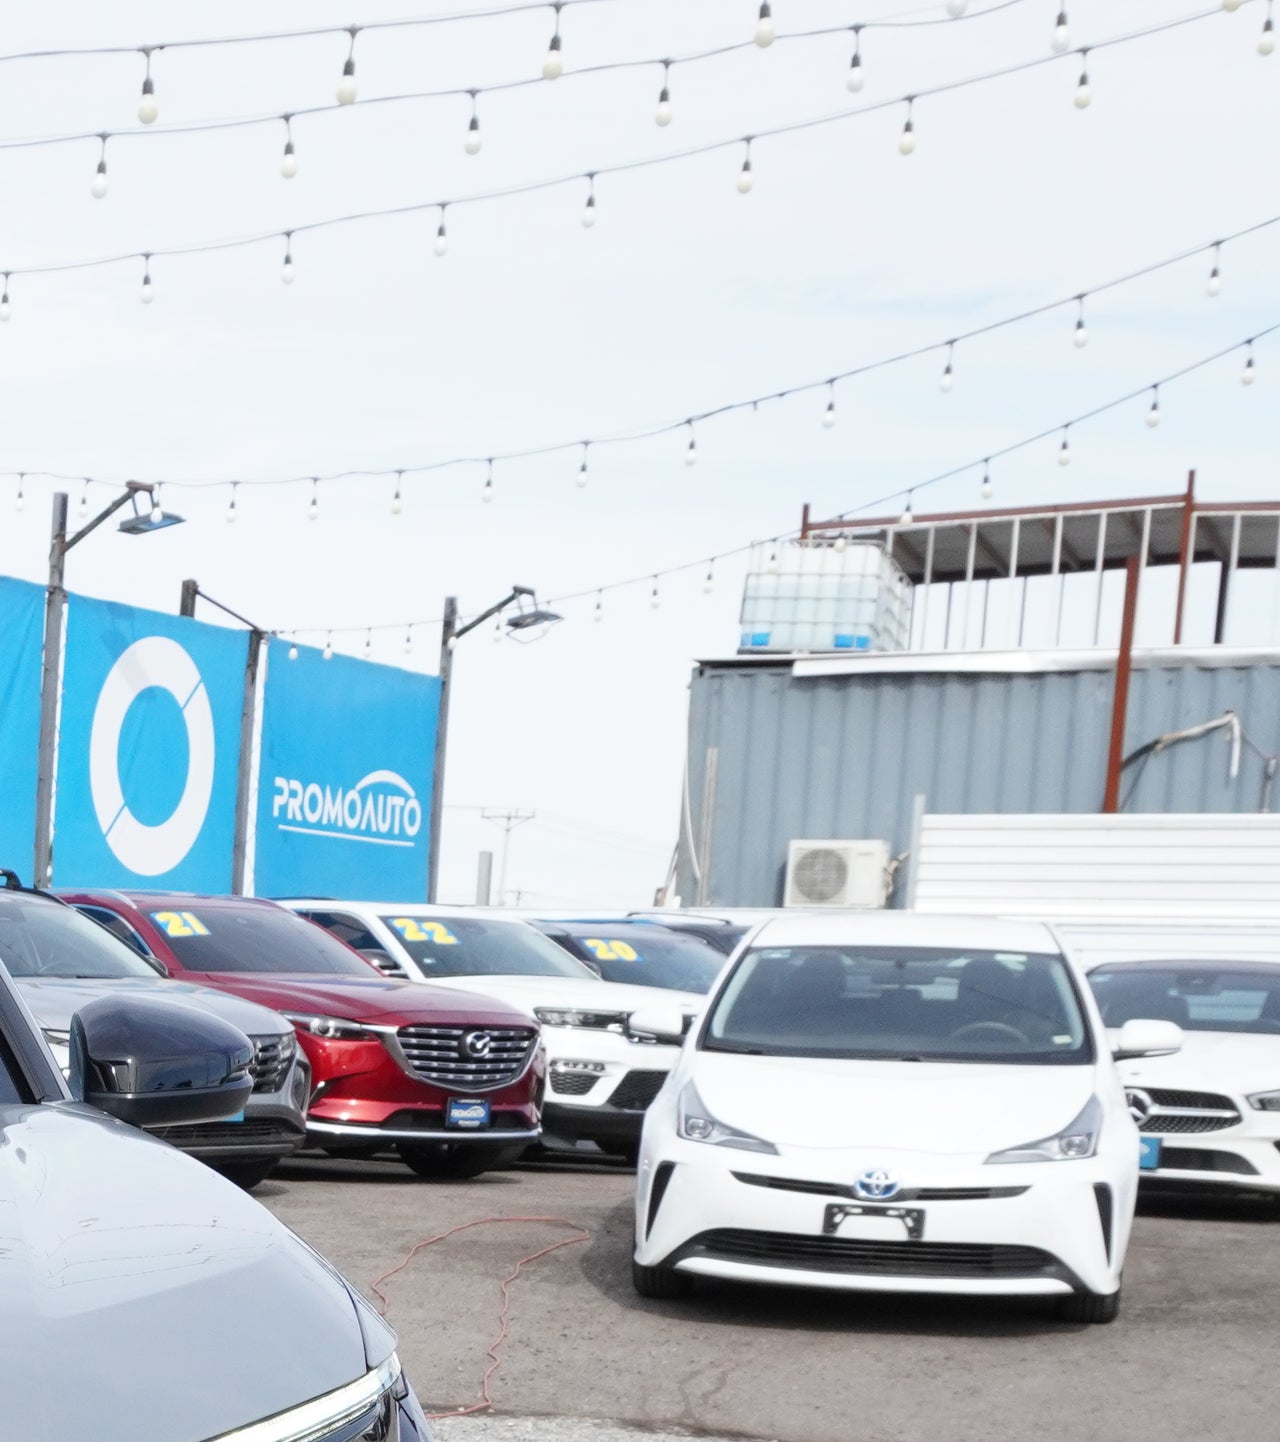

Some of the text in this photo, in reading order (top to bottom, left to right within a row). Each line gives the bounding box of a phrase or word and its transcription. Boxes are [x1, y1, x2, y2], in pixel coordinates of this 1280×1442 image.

[273, 776, 421, 836] PROMOAUTO
[156, 911, 208, 936] 21
[392, 918, 458, 945] 22
[584, 938, 637, 961] 20
